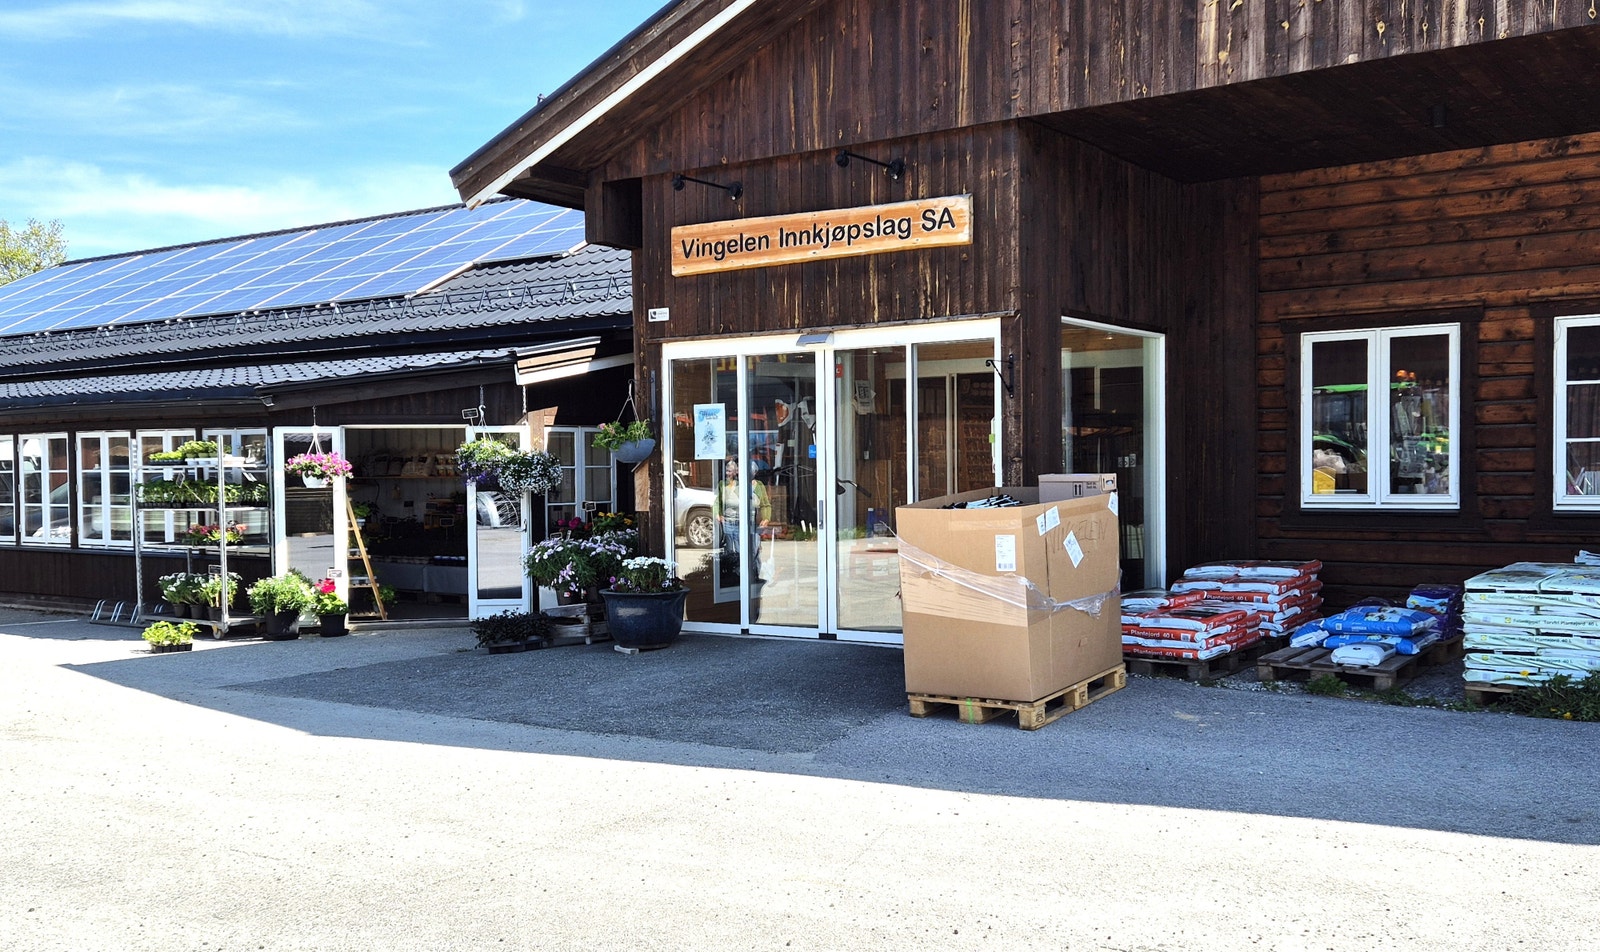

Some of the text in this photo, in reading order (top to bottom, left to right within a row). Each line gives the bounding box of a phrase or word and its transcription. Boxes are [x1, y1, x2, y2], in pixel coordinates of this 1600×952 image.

[681, 207, 956, 261] Vingelen Innkjøpslag SA
[1130, 629, 1160, 638] Plantejord
[1133, 648, 1163, 656] Plantejord
